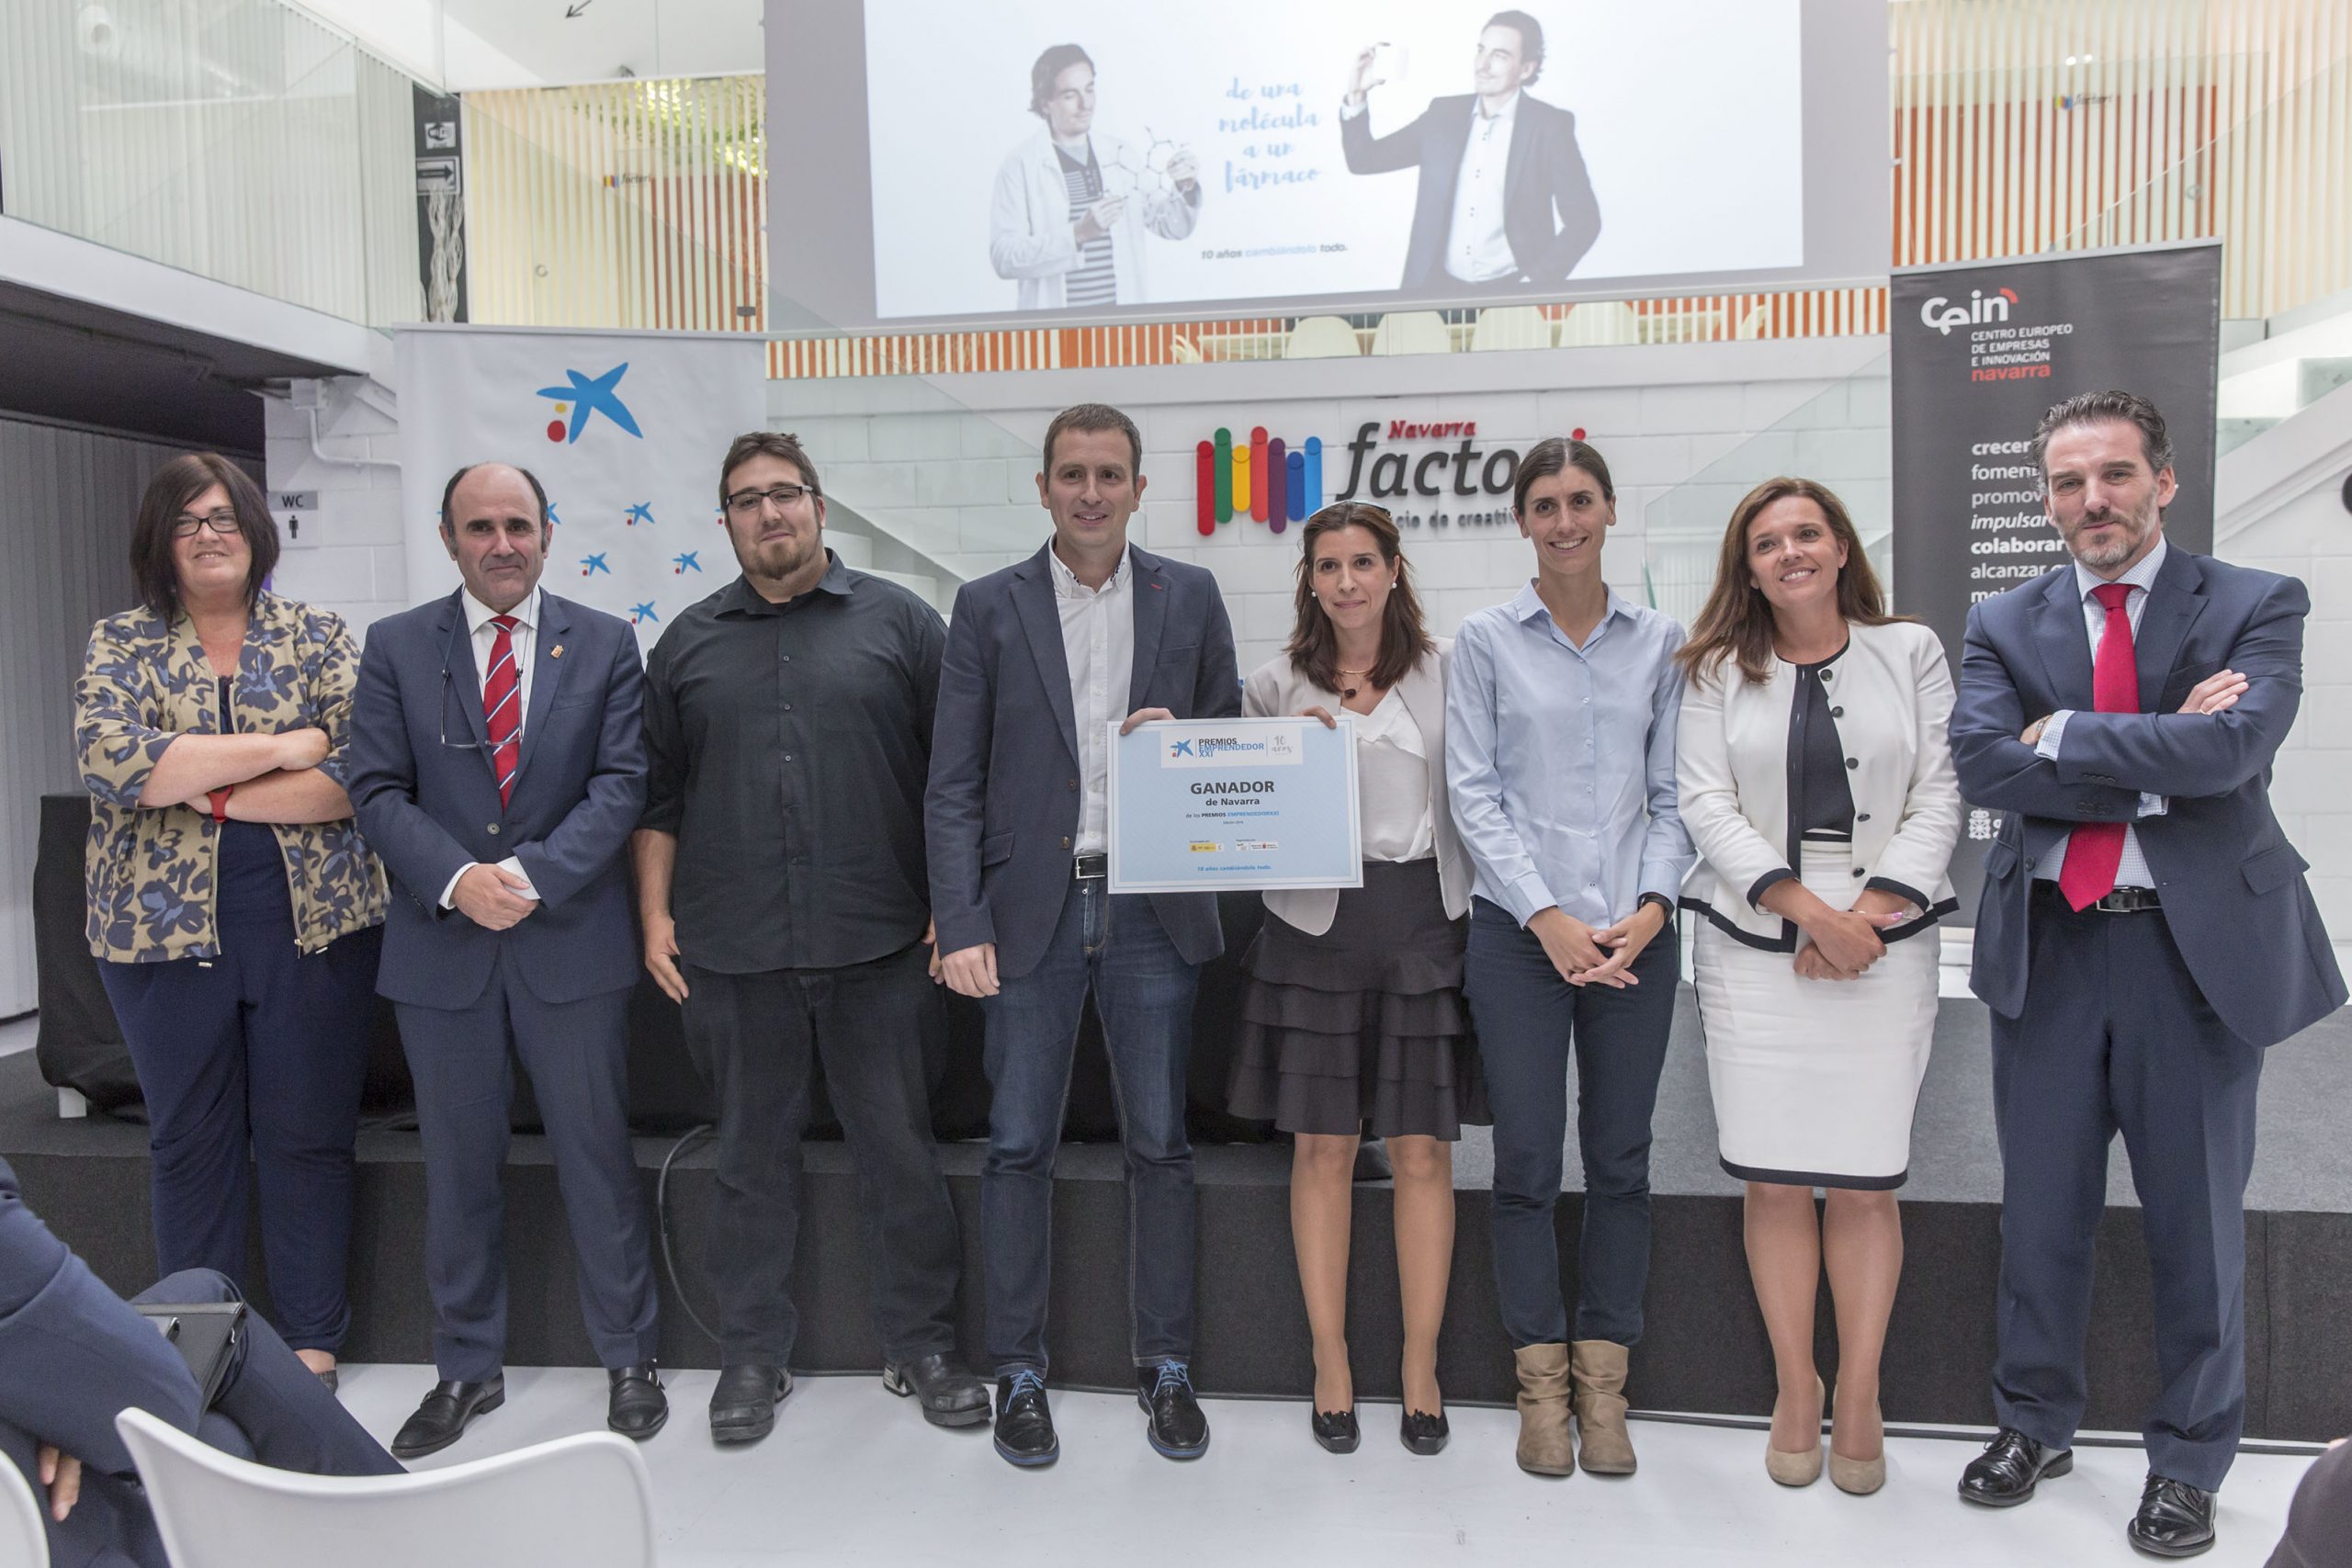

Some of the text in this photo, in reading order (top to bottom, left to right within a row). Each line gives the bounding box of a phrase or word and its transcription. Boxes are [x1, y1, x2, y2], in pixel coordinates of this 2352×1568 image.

[1226, 77, 1251, 100] de
[1243, 144, 1258, 158] a
[1201, 250, 1214, 259] 10
[1216, 249, 1242, 259] años
[1971, 323, 2074, 342] CENTRO EUROPEO
[1972, 339, 2050, 355] DE EMPRESAS
[1972, 351, 2051, 367] E INNOVACIÓN
[1972, 365, 2051, 382] navarra
[1388, 421, 1476, 439] Navarra
[1972, 441, 2031, 456] crecer
[1335, 423, 1521, 502] facto
[281, 494, 304, 508] WC
[1972, 491, 2043, 509] promov
[1429, 509, 1449, 527] de
[1971, 537, 2064, 555] colaborar
[1971, 562, 2046, 580] alcanzar
[1198, 738, 1238, 746] PREMIOS
[1199, 743, 1264, 752] EMPRENDEDOR
[1190, 781, 1274, 795] GANADOR
